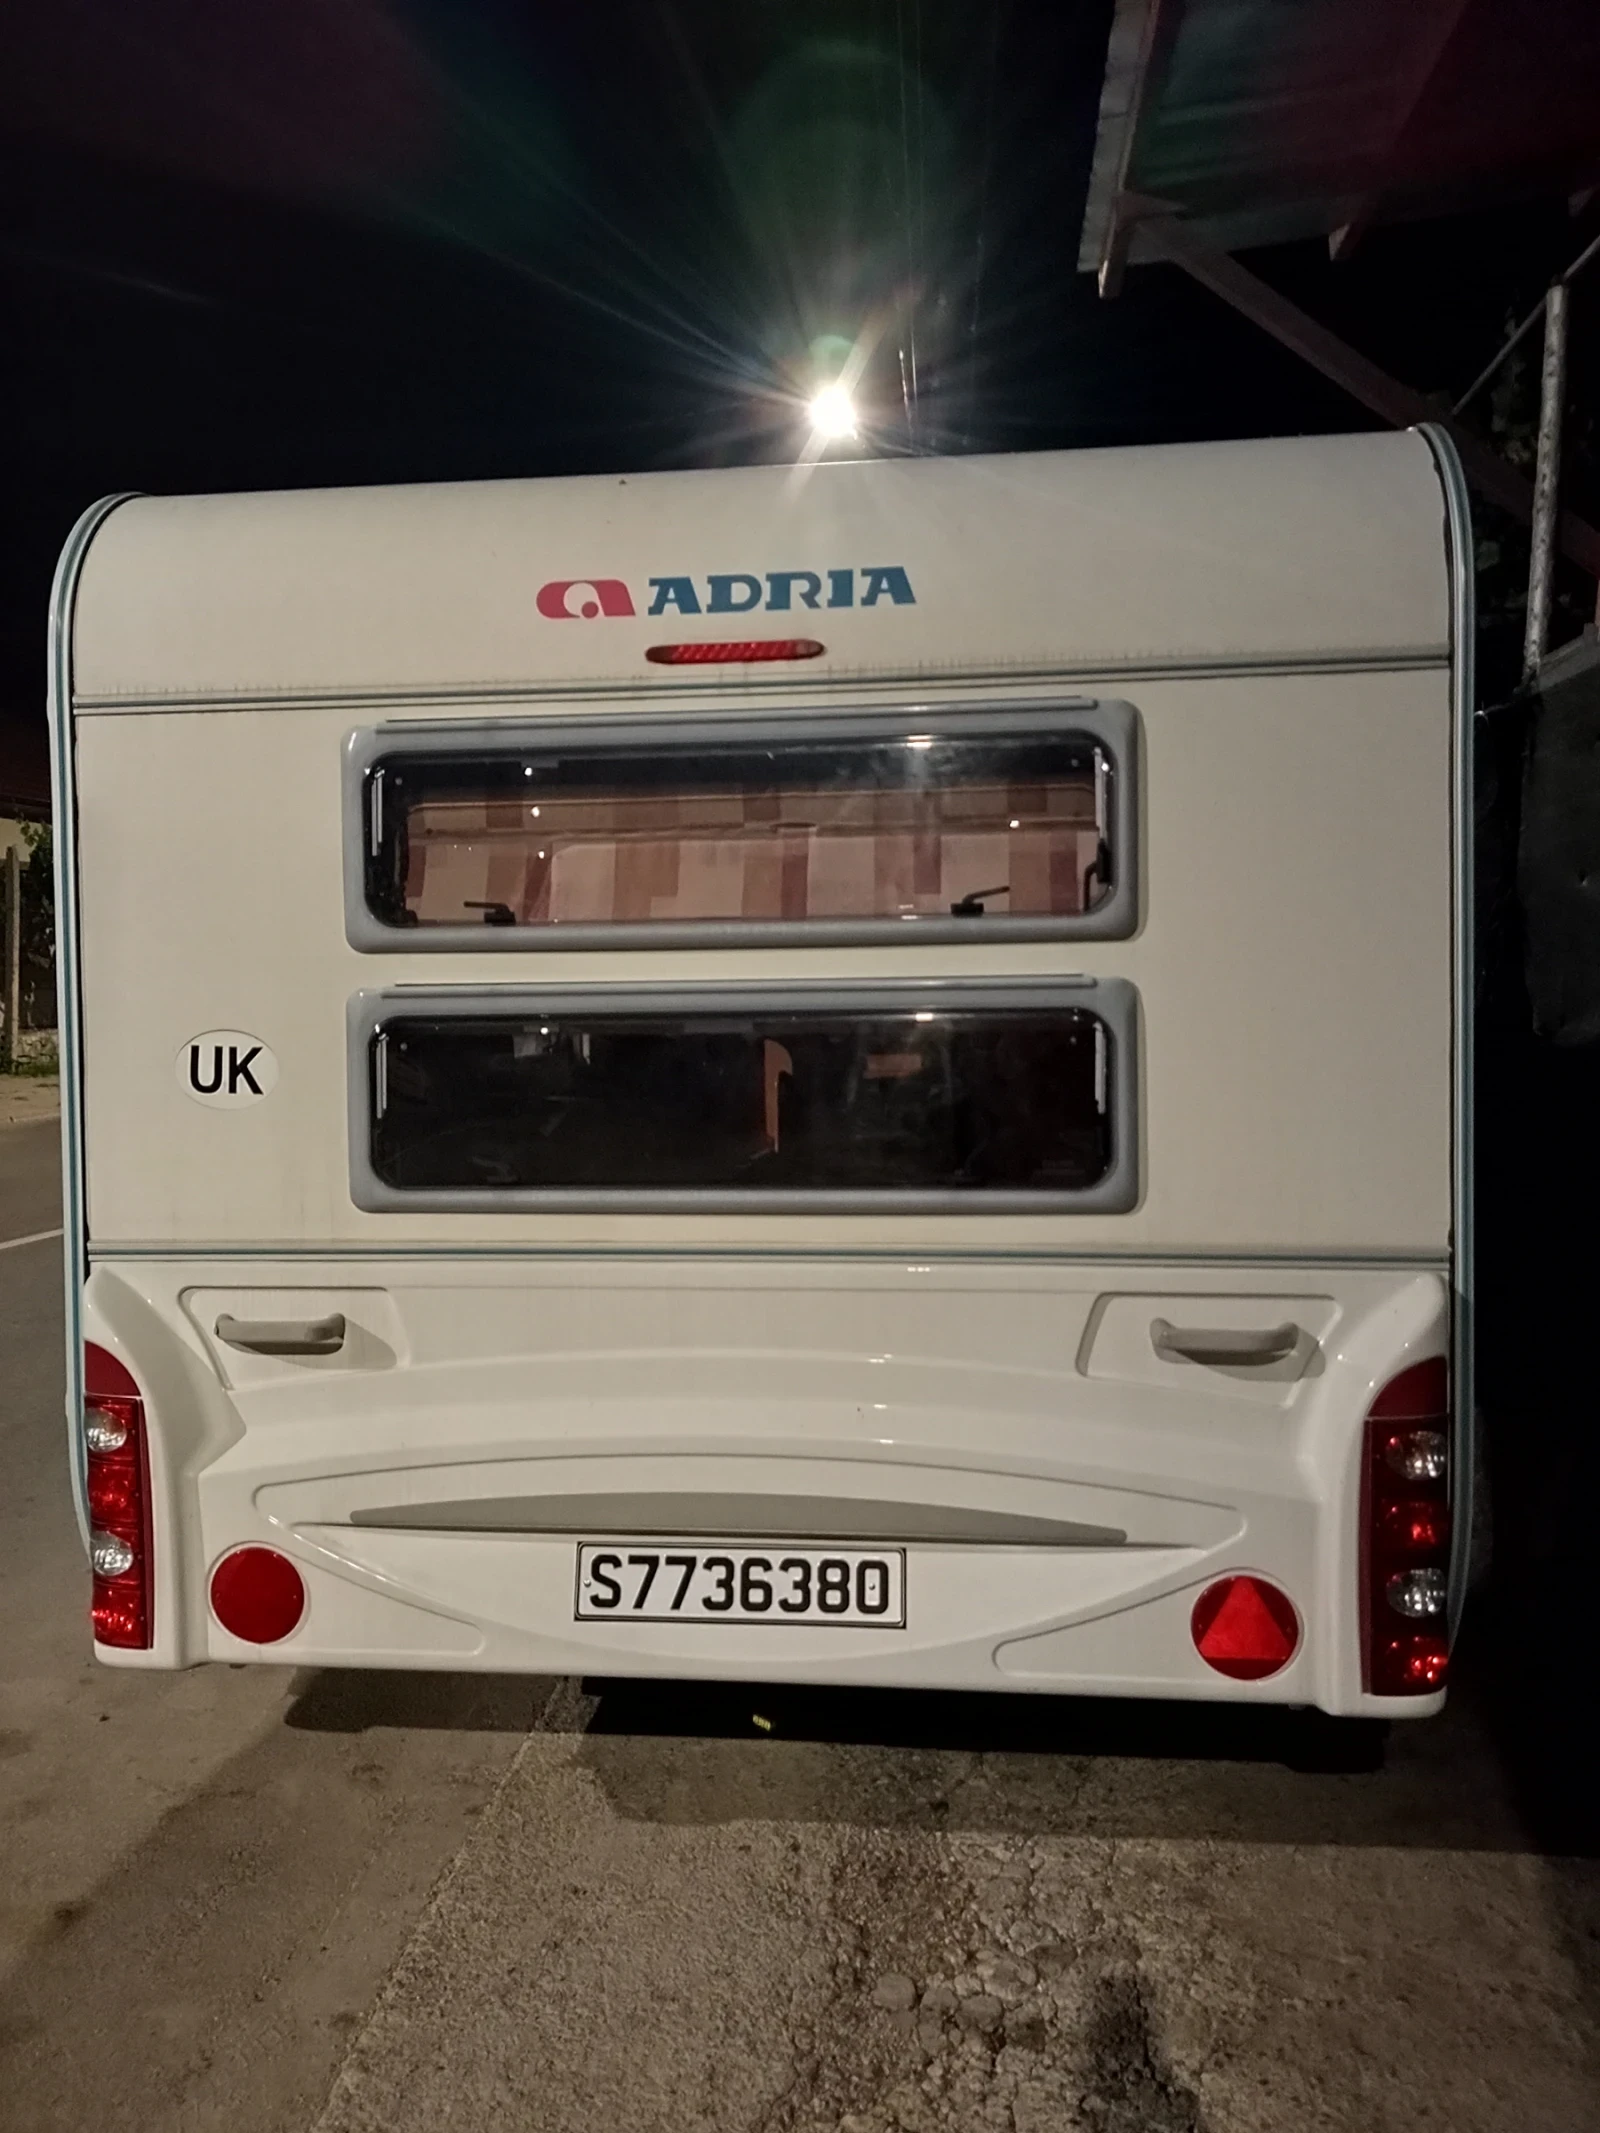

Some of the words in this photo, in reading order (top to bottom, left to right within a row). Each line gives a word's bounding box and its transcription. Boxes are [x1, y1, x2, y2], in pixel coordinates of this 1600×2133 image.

[648, 566, 917, 616] ADRIA
[190, 1045, 264, 1095] UK
[589, 1554, 889, 1614] S7736380
